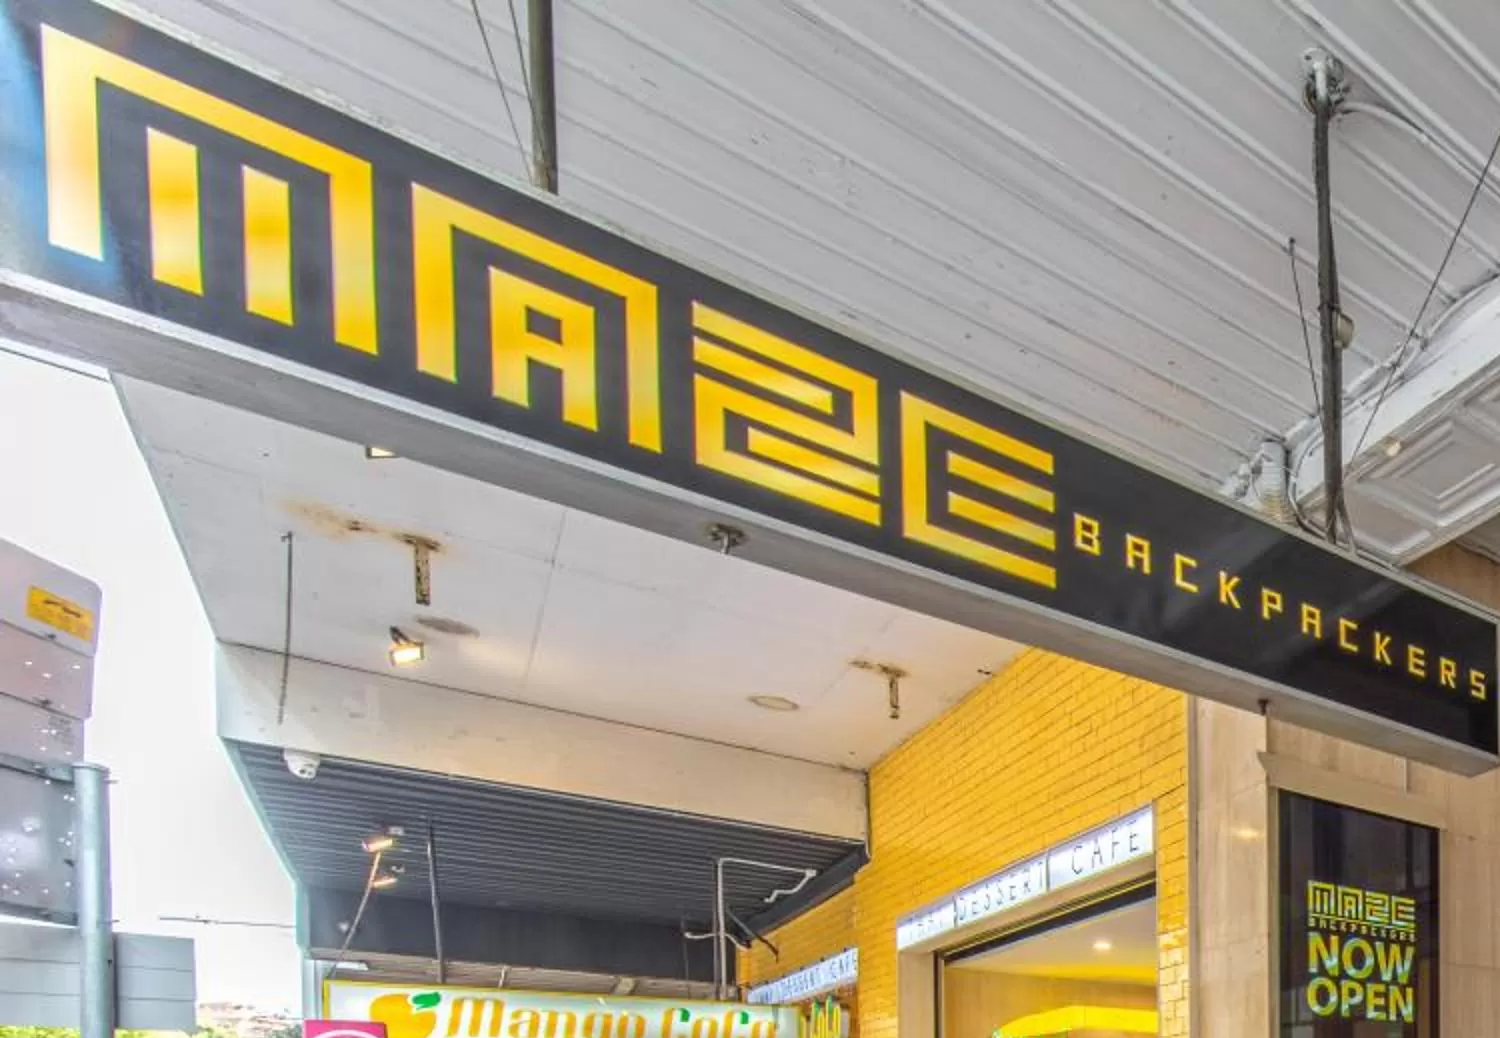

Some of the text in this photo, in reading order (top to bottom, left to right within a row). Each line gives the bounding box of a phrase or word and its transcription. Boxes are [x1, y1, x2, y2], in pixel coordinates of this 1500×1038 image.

[41, 24, 1489, 700] MAZE BACKPACKERS
[1071, 818, 1140, 876] CAFE
[1307, 880, 1416, 928] MAZE
[1308, 931, 1416, 984] NOW
[1307, 977, 1414, 1023] OPEN
